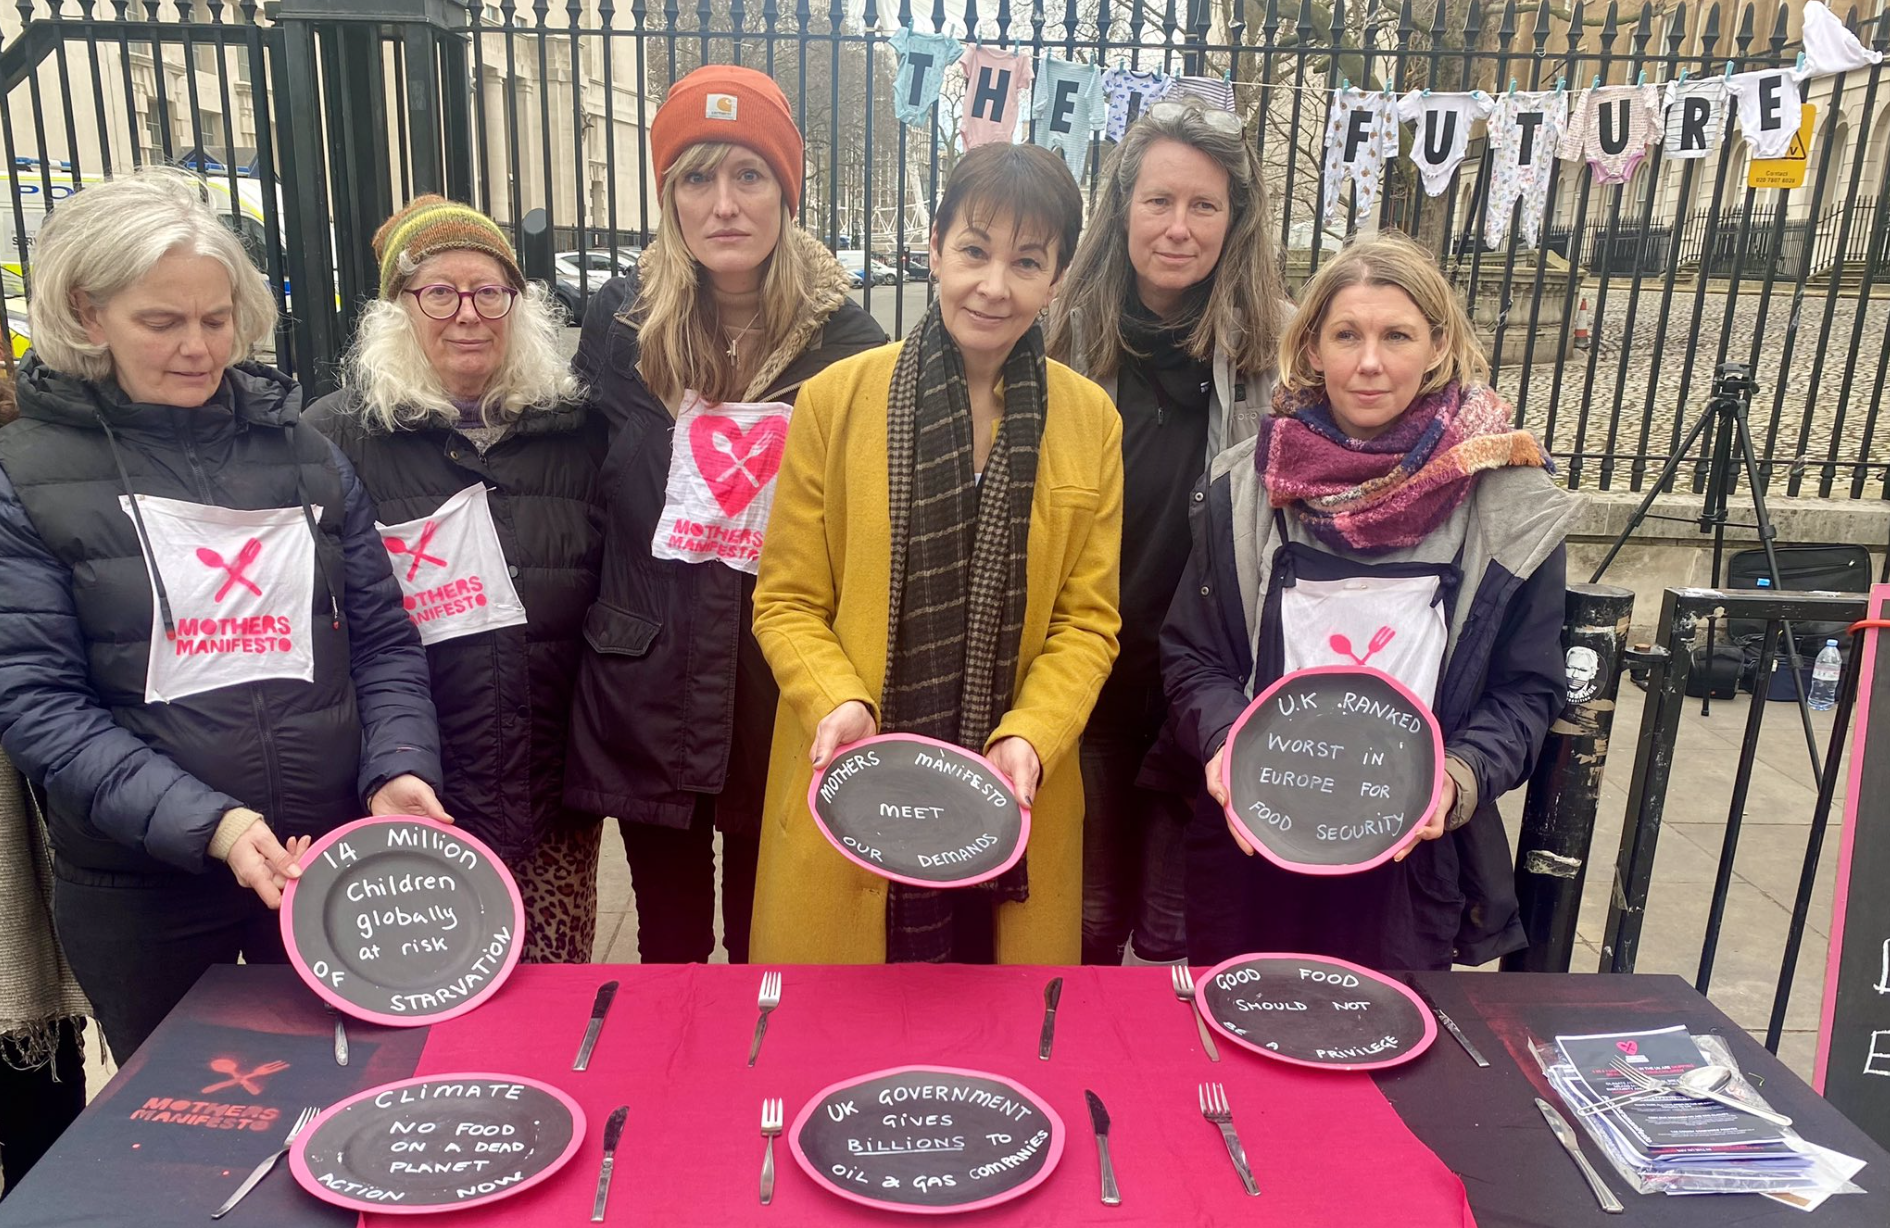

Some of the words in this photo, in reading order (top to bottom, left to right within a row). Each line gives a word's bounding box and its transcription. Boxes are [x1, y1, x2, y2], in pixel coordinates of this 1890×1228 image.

[1343, 75, 1783, 166] FUTURE
[673, 518, 763, 549] MOTHERS
[402, 576, 484, 611] OTHERS
[409, 593, 487, 627] ANIFESTO
[177, 615, 291, 637] MOTHERS
[175, 636, 292, 656] MANIFESTO
[1342, 692, 1421, 733] RANKED
[1268, 732, 1345, 760] WORST
[819, 751, 881, 804] MOTHERS
[1259, 767, 1335, 793] EUROPE
[1361, 782, 1391, 799] FOR
[880, 803, 945, 819] MEET
[1249, 801, 1293, 832] FOOD
[323, 842, 358, 869] 14
[842, 836, 884, 862] OUR
[917, 833, 999, 868] DEMANDS
[346, 874, 456, 902] Children
[356, 905, 458, 939] globally
[359, 944, 381, 960] at
[401, 936, 448, 956] risk
[312, 960, 346, 988] OF
[1216, 968, 1262, 991] GOOD
[1299, 968, 1360, 988] FOOD
[1235, 998, 1308, 1012] SHOULD
[1331, 1001, 1371, 1012] NOT
[1223, 1021, 1247, 1036] BE
[1266, 1041, 1280, 1051] A
[142, 1097, 281, 1121] MOTHERS
[827, 1100, 859, 1122] UK
[878, 1085, 1032, 1122] GOVERNMENT
[129, 1109, 271, 1132] MANIFESTO
[390, 1121, 437, 1135] NO
[455, 1122, 516, 1136] FOOD
[390, 1142, 426, 1153] ON
[444, 1142, 461, 1153] A
[474, 1142, 525, 1153] DEAD
[985, 1133, 1013, 1147] TO
[389, 1160, 490, 1174] PLANET
[456, 1171, 524, 1199] NOW
[912, 1174, 957, 1193] GAS
